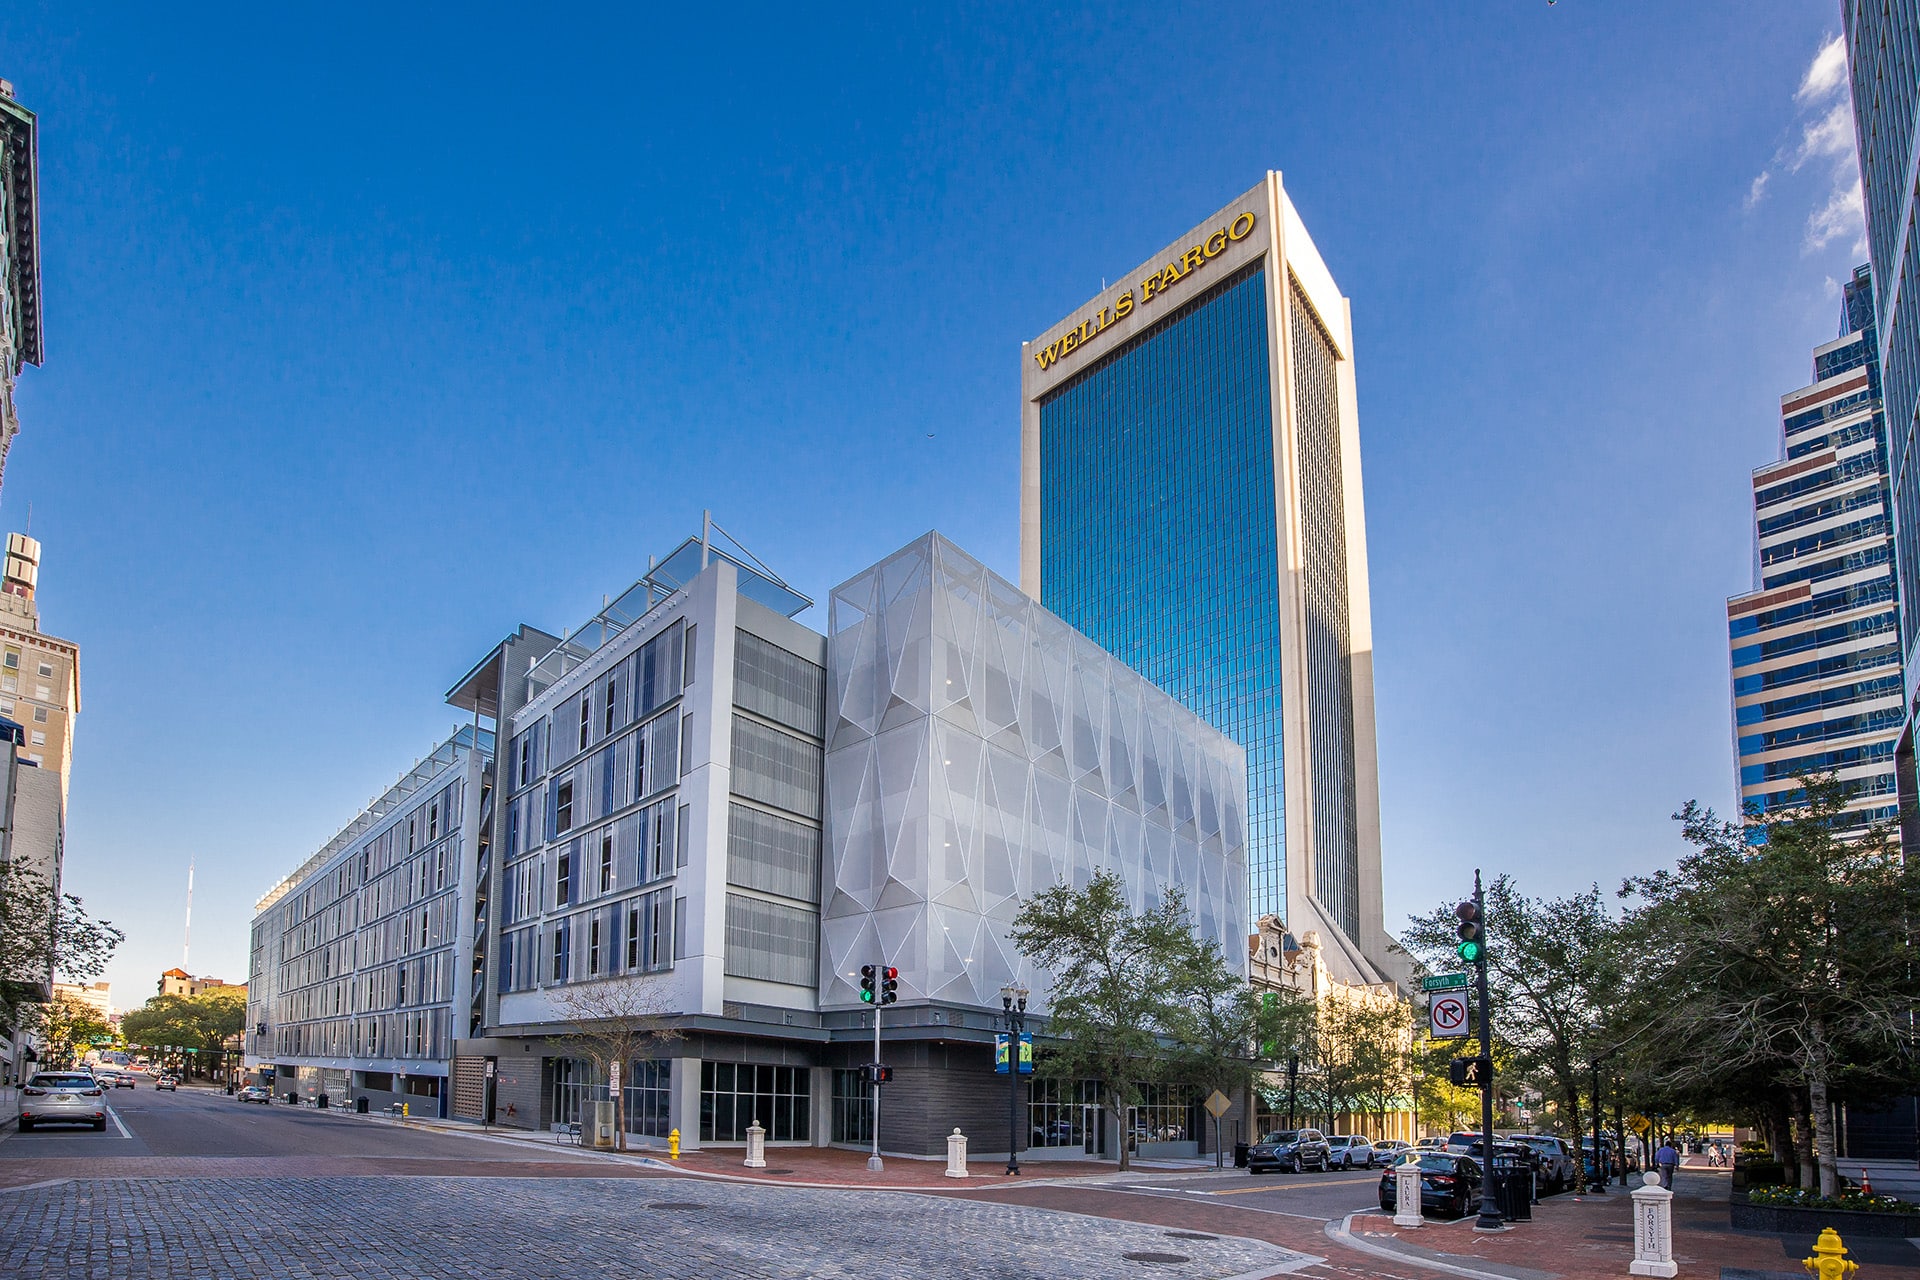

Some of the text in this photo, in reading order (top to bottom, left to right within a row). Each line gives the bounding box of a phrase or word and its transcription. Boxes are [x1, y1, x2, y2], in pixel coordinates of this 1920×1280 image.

[1035, 211, 1256, 371] WELLS FARGO
[1424, 976, 1450, 988] Forsyth
[1646, 1207, 1656, 1249] FORSYTH
